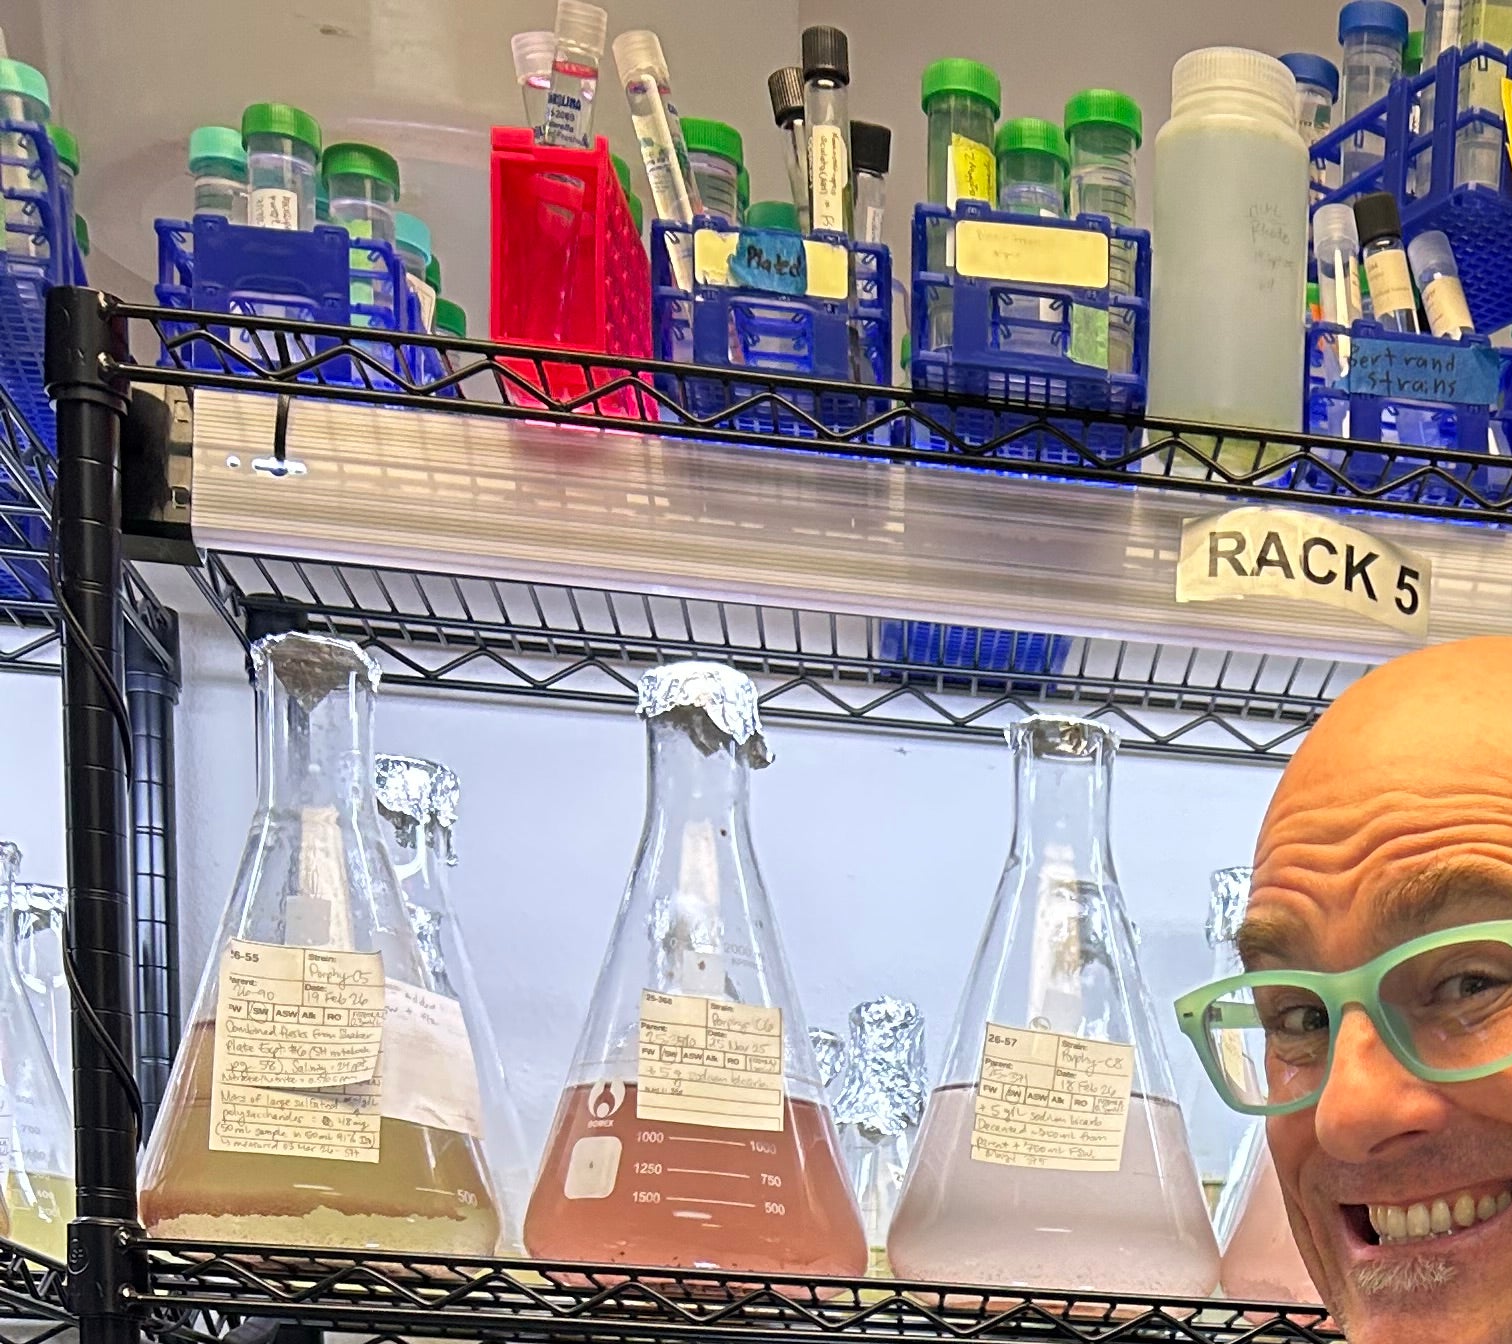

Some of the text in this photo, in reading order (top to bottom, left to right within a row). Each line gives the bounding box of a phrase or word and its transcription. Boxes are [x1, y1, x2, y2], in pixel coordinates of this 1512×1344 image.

[1208, 530, 1420, 616] RACK 5
[276, 1009, 299, 1018] ASW
[327, 1013, 342, 1021] RO
[637, 1132, 664, 1144] 1000
[634, 1163, 782, 1188] 1250 750
[457, 1189, 478, 1207] 500
[632, 1191, 786, 1216] 1500 500
